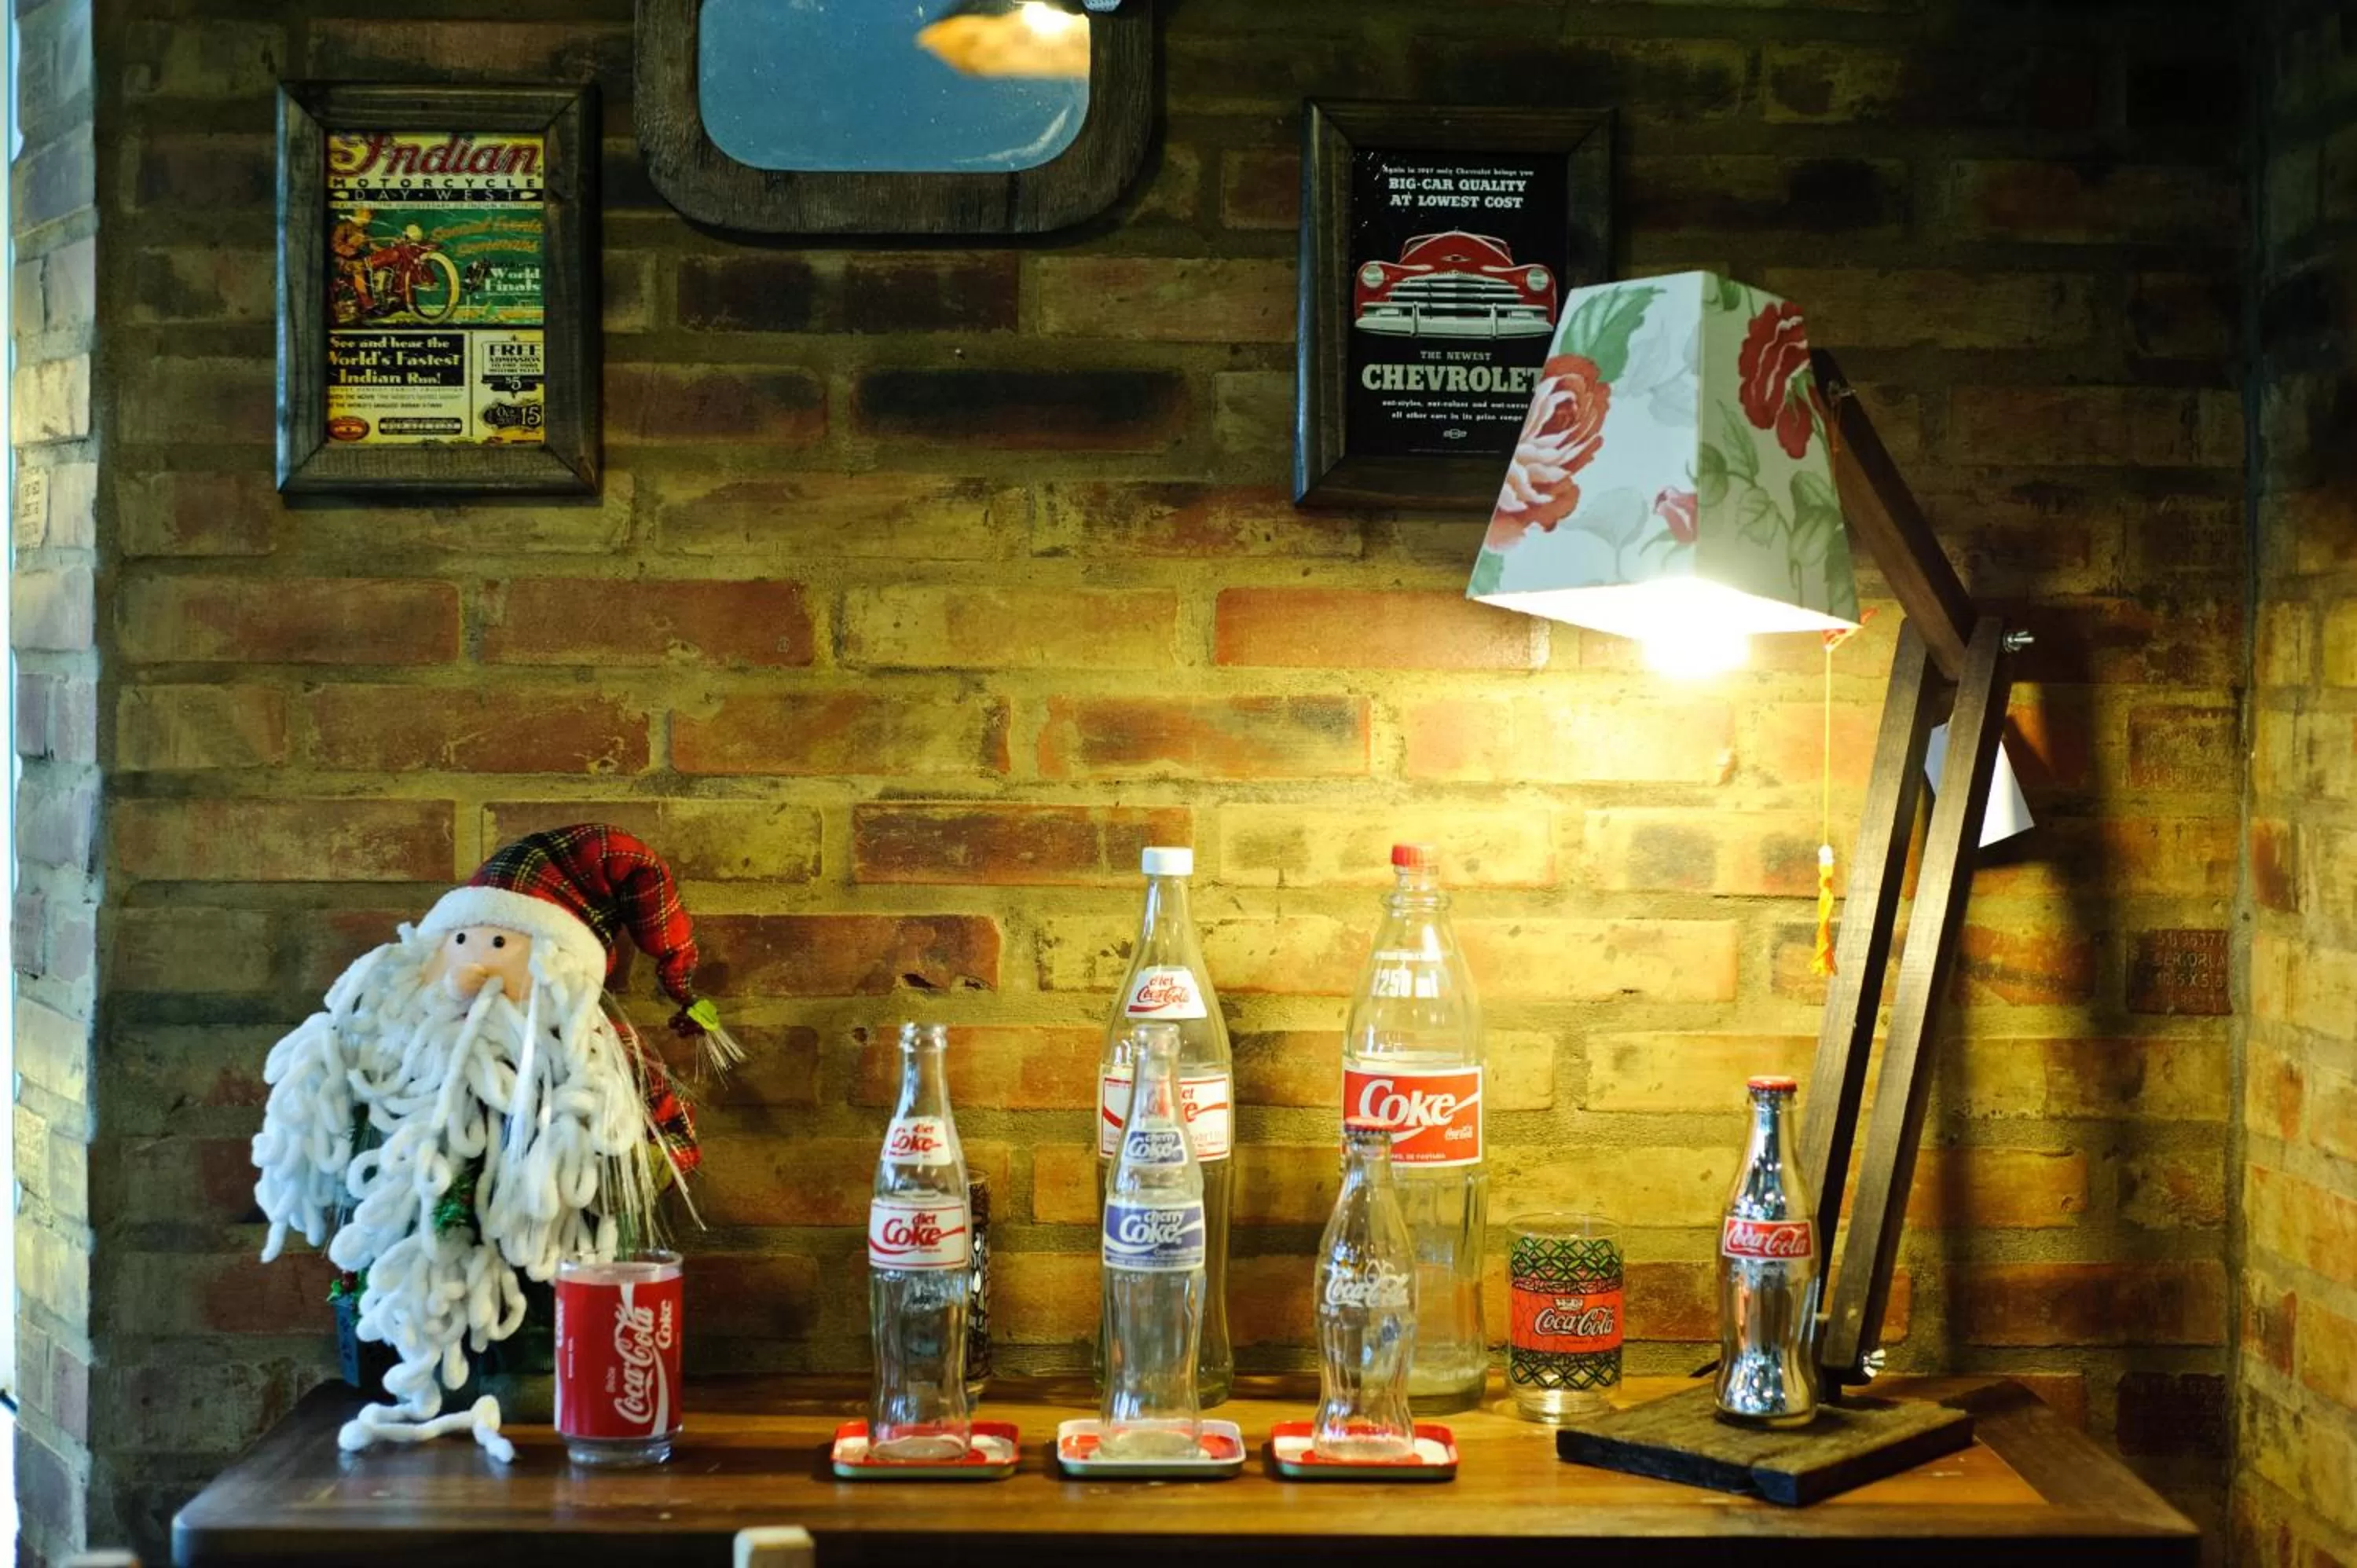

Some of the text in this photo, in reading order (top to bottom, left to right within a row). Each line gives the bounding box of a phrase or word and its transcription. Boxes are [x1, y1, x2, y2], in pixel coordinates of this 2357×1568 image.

[328, 134, 539, 177] Indian
[1436, 167, 1453, 176] only
[1456, 167, 1491, 176] Chevrolet
[1494, 167, 1517, 177] brings
[333, 178, 535, 188] MOTORCYCLE
[1388, 177, 1527, 192] BIG-CAR QUALITY
[354, 189, 514, 200] DAY WEST
[1390, 193, 1524, 209] AT LOWEST COST
[490, 268, 541, 279] World
[485, 279, 541, 291] Finals
[330, 336, 450, 348] See and hear the
[489, 344, 541, 355] FREE
[396, 350, 463, 365] Fastest
[1420, 350, 1494, 361] THE NEWEST
[339, 368, 441, 384] Indian Run!
[1362, 364, 1543, 394] CHEVROLET
[1472, 399, 1487, 409] and
[521, 406, 541, 426] 15
[1476, 412, 1497, 422] price
[1149, 975, 1174, 986] diet
[1137, 985, 1190, 1003] Coca-Cola
[1358, 1079, 1456, 1127] Coke
[912, 1123, 934, 1134] diet
[892, 1127, 934, 1152] Coke
[1127, 1137, 1173, 1158] Coke
[912, 1212, 937, 1225] diet
[1144, 1211, 1186, 1227] cherry
[882, 1218, 942, 1246] Coke
[1119, 1214, 1178, 1244] Coke
[1726, 1222, 1808, 1255] Coca-Cola
[655, 1298, 673, 1350] Coke
[1534, 1306, 1615, 1336] Coca-Cola
[614, 1302, 654, 1425] Coca-Cola
